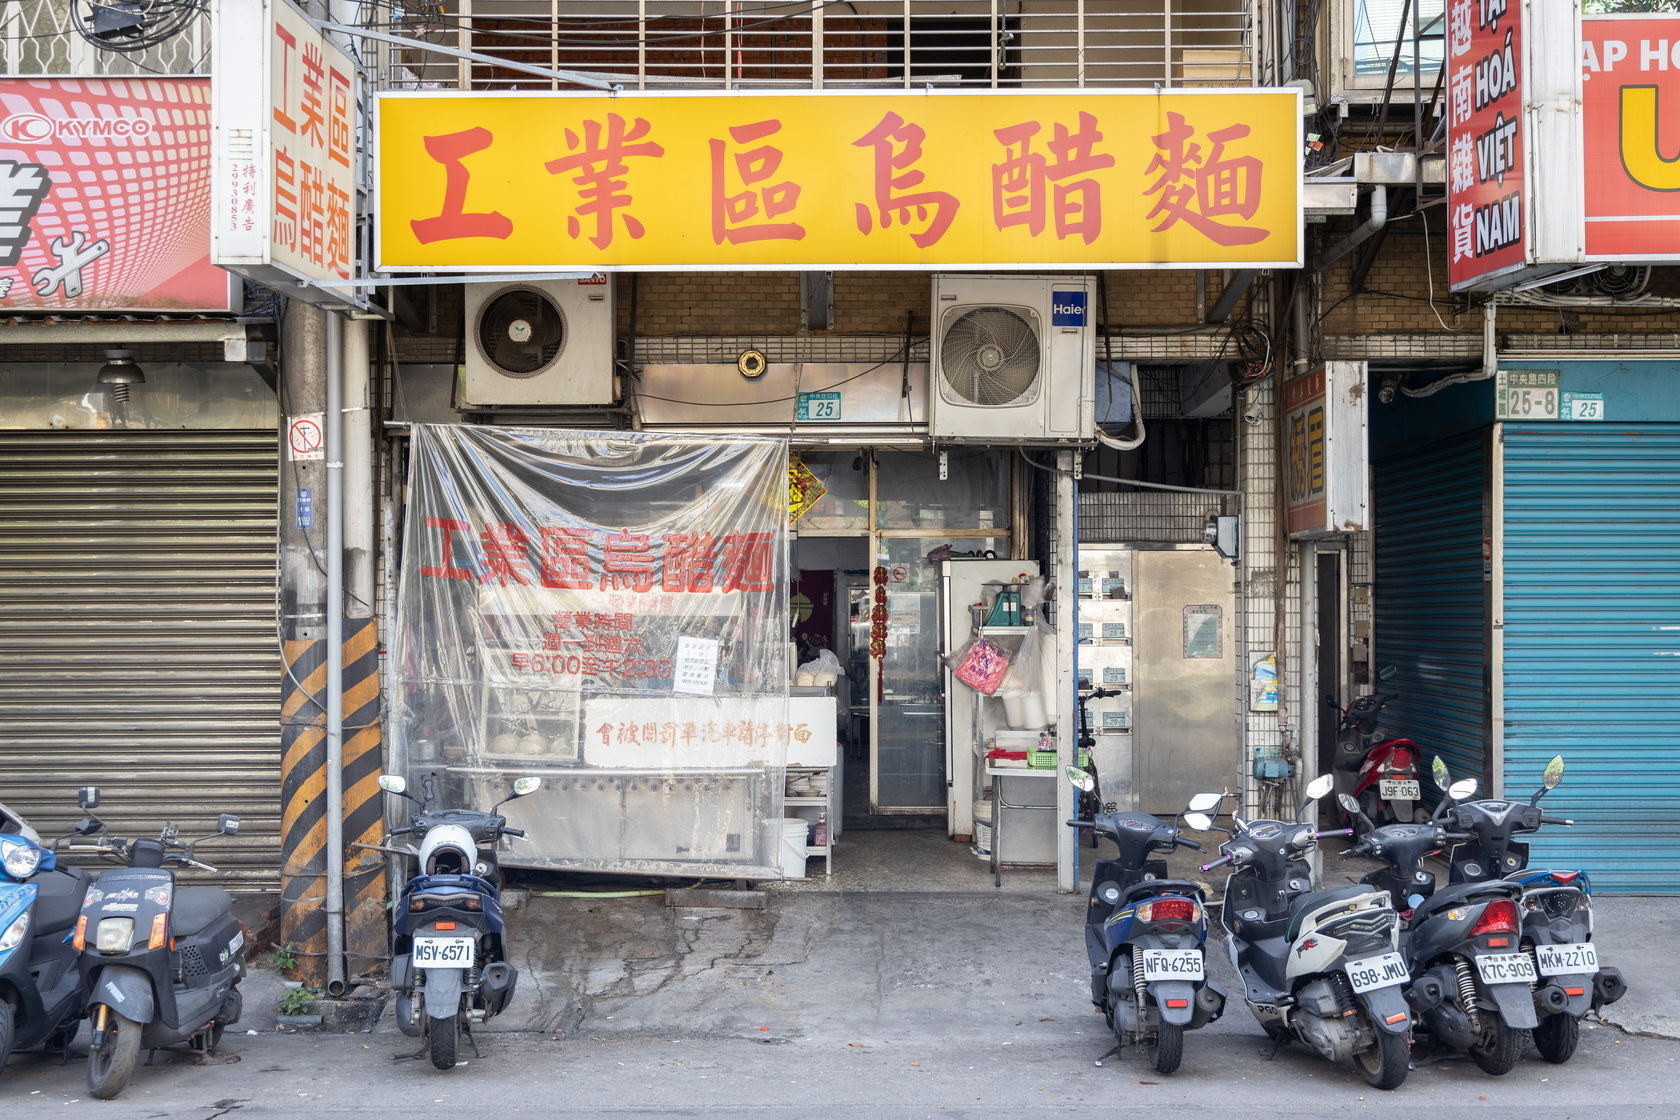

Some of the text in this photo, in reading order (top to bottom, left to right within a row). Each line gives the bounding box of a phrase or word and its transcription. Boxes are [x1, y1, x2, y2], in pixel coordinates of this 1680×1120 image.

[1476, 29, 1516, 110] HOÁ
[58, 118, 151, 138] KYMCO
[1477, 114, 1517, 187] VIỆT
[410, 111, 1270, 250] 工業區烏醋麵
[230, 164, 239, 231] 29930853
[242, 164, 256, 231] 特利廣告
[1476, 194, 1520, 256] NAM
[1053, 303, 1087, 315] Haier
[1510, 373, 1556, 385] 中央路四段
[816, 402, 834, 416] 25
[1510, 390, 1555, 415] 25-8
[1579, 402, 1598, 417] 25
[420, 517, 775, 594] 工業區烏醋麵
[554, 610, 633, 632] 營業時間
[542, 632, 643, 655] 週一到週六
[511, 652, 672, 679] 早6:00至午2:30
